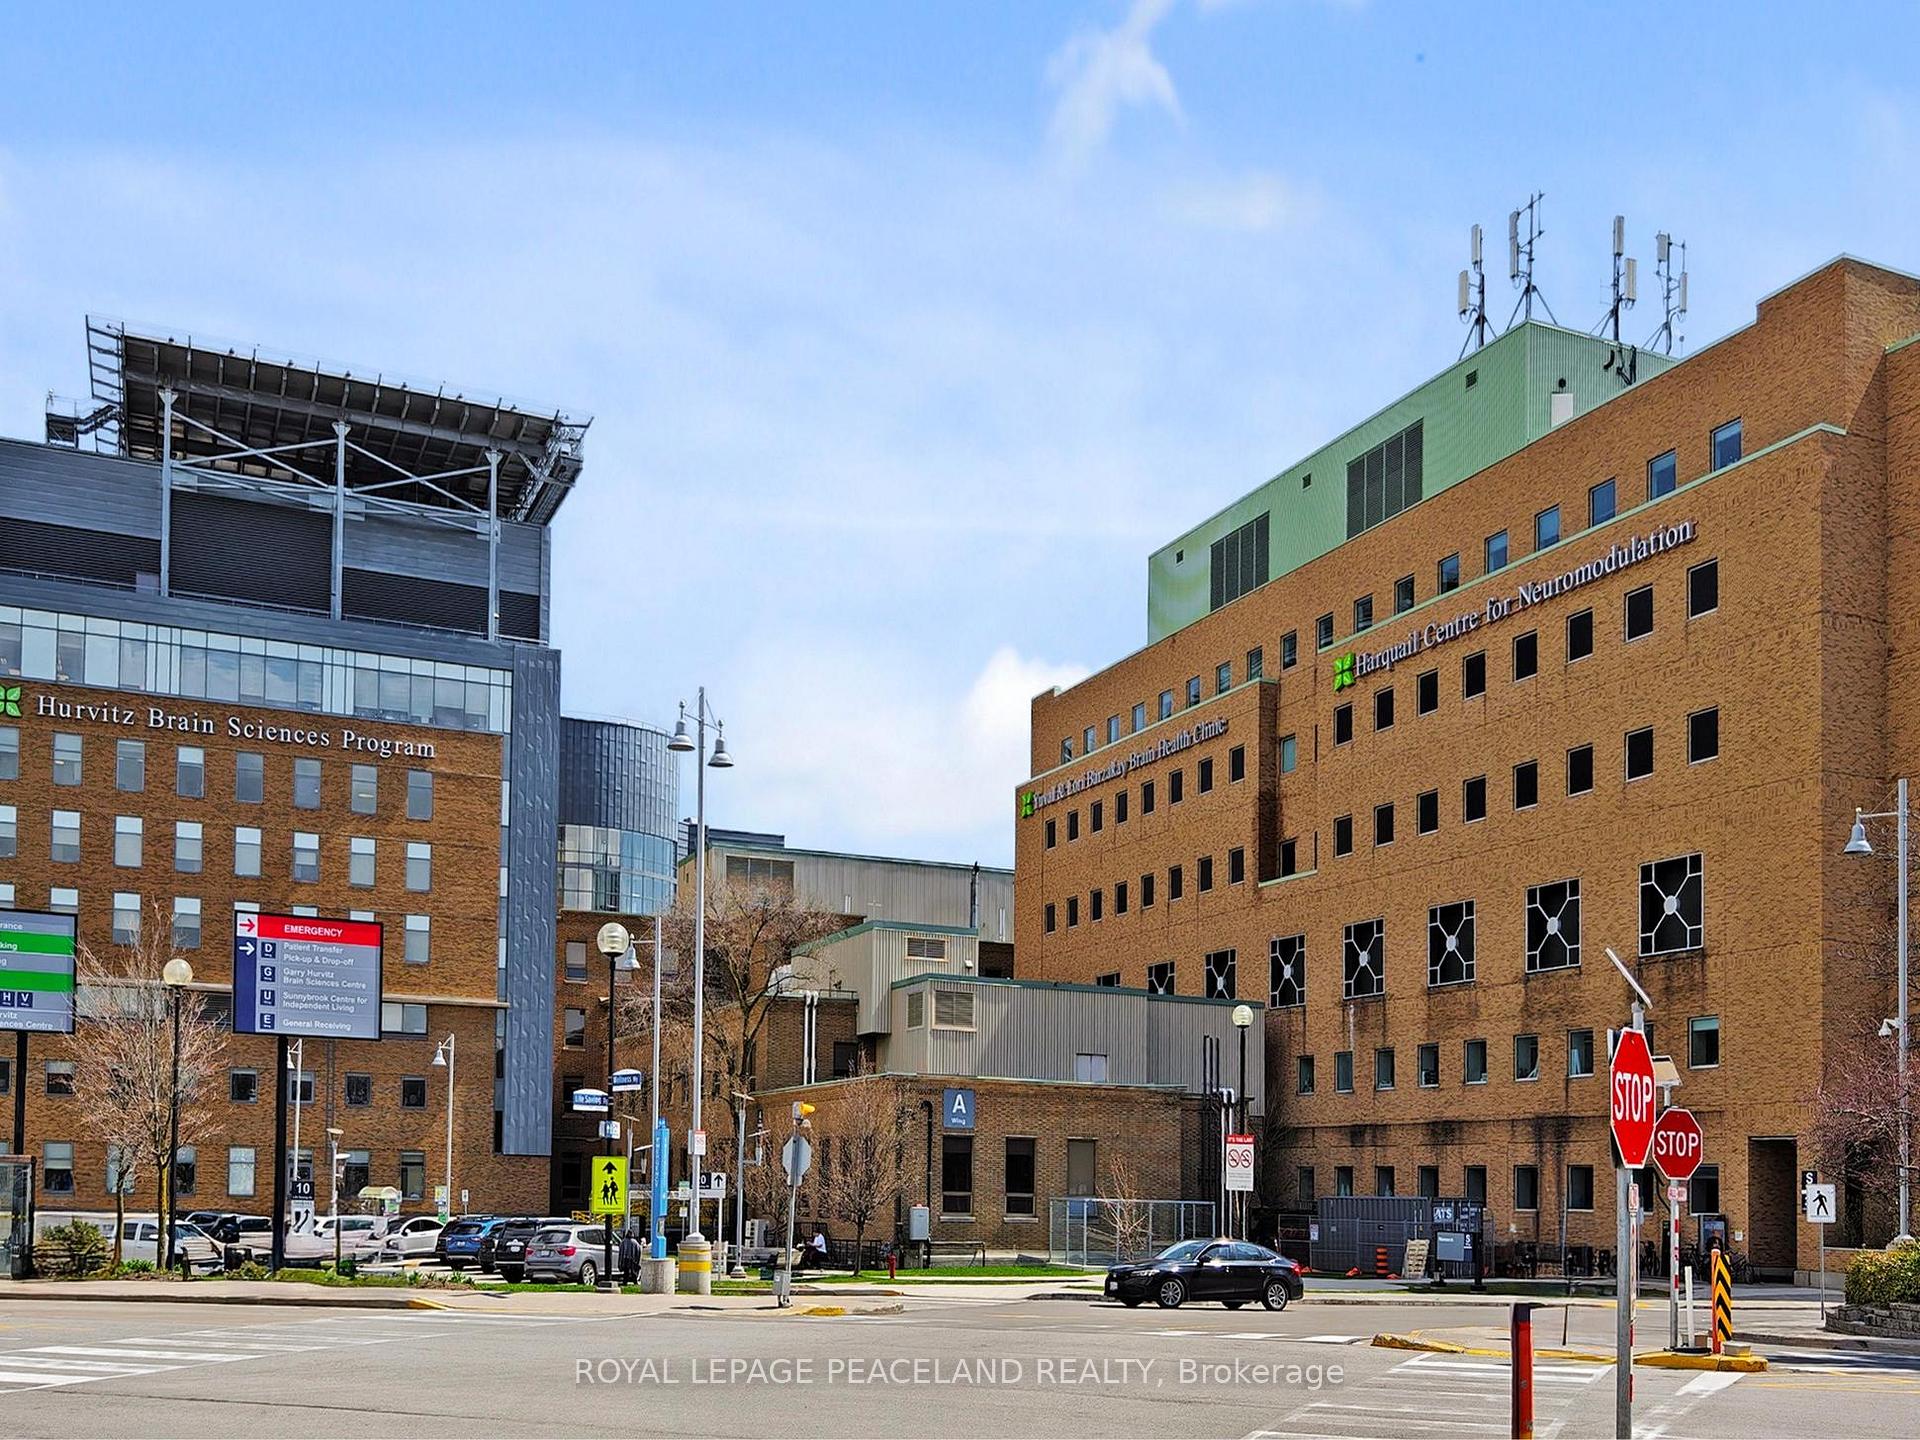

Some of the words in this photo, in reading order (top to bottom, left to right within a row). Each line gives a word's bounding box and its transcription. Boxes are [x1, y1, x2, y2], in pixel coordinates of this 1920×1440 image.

[1355, 630, 1420, 677] Harquail
[1423, 610, 1480, 647] Centre
[1486, 596, 1511, 622] for
[1518, 520, 1693, 609] Neuromodulation
[37, 695, 135, 725] Hurvitz
[148, 707, 215, 734] Brain
[228, 716, 330, 746] Sciences
[341, 729, 436, 758] Program
[1129, 748, 1156, 770] Brain
[1158, 731, 1191, 757] Health
[1192, 717, 1227, 744] Clinic
[284, 924, 343, 937] EMERGENCY
[265, 944, 273, 952] D
[283, 942, 312, 951] Patient
[313, 944, 344, 954] Transfer
[283, 954, 312, 964] Pick-up
[314, 956, 321, 964] &
[322, 956, 354, 966] Drop-off
[264, 967, 272, 976] G
[283, 967, 305, 978] Garry
[307, 969, 335, 979] Hurvitz
[283, 976, 303, 985] Brain
[305, 978, 340, 988] Sciences
[341, 980, 367, 989] Centre
[3, 992, 11, 1001] H
[21, 993, 29, 1002] V
[264, 991, 272, 1000] U
[283, 992, 328, 1002] Sunnybrook
[330, 994, 355, 1003] Centre
[356, 995, 368, 1004] for
[283, 1001, 330, 1011] Independent
[331, 1003, 355, 1013] Living
[26, 1021, 54, 1030] Centre
[264, 1015, 272, 1024] E
[283, 1019, 314, 1028] General
[315, 1021, 352, 1031] Receiving
[1614, 1071, 1653, 1123] STOP
[952, 1093, 966, 1114] A
[950, 1117, 966, 1126] Wing
[1656, 1130, 1699, 1157] STOP
[1805, 1172, 1814, 1185] S
[296, 1182, 310, 1194] 10
